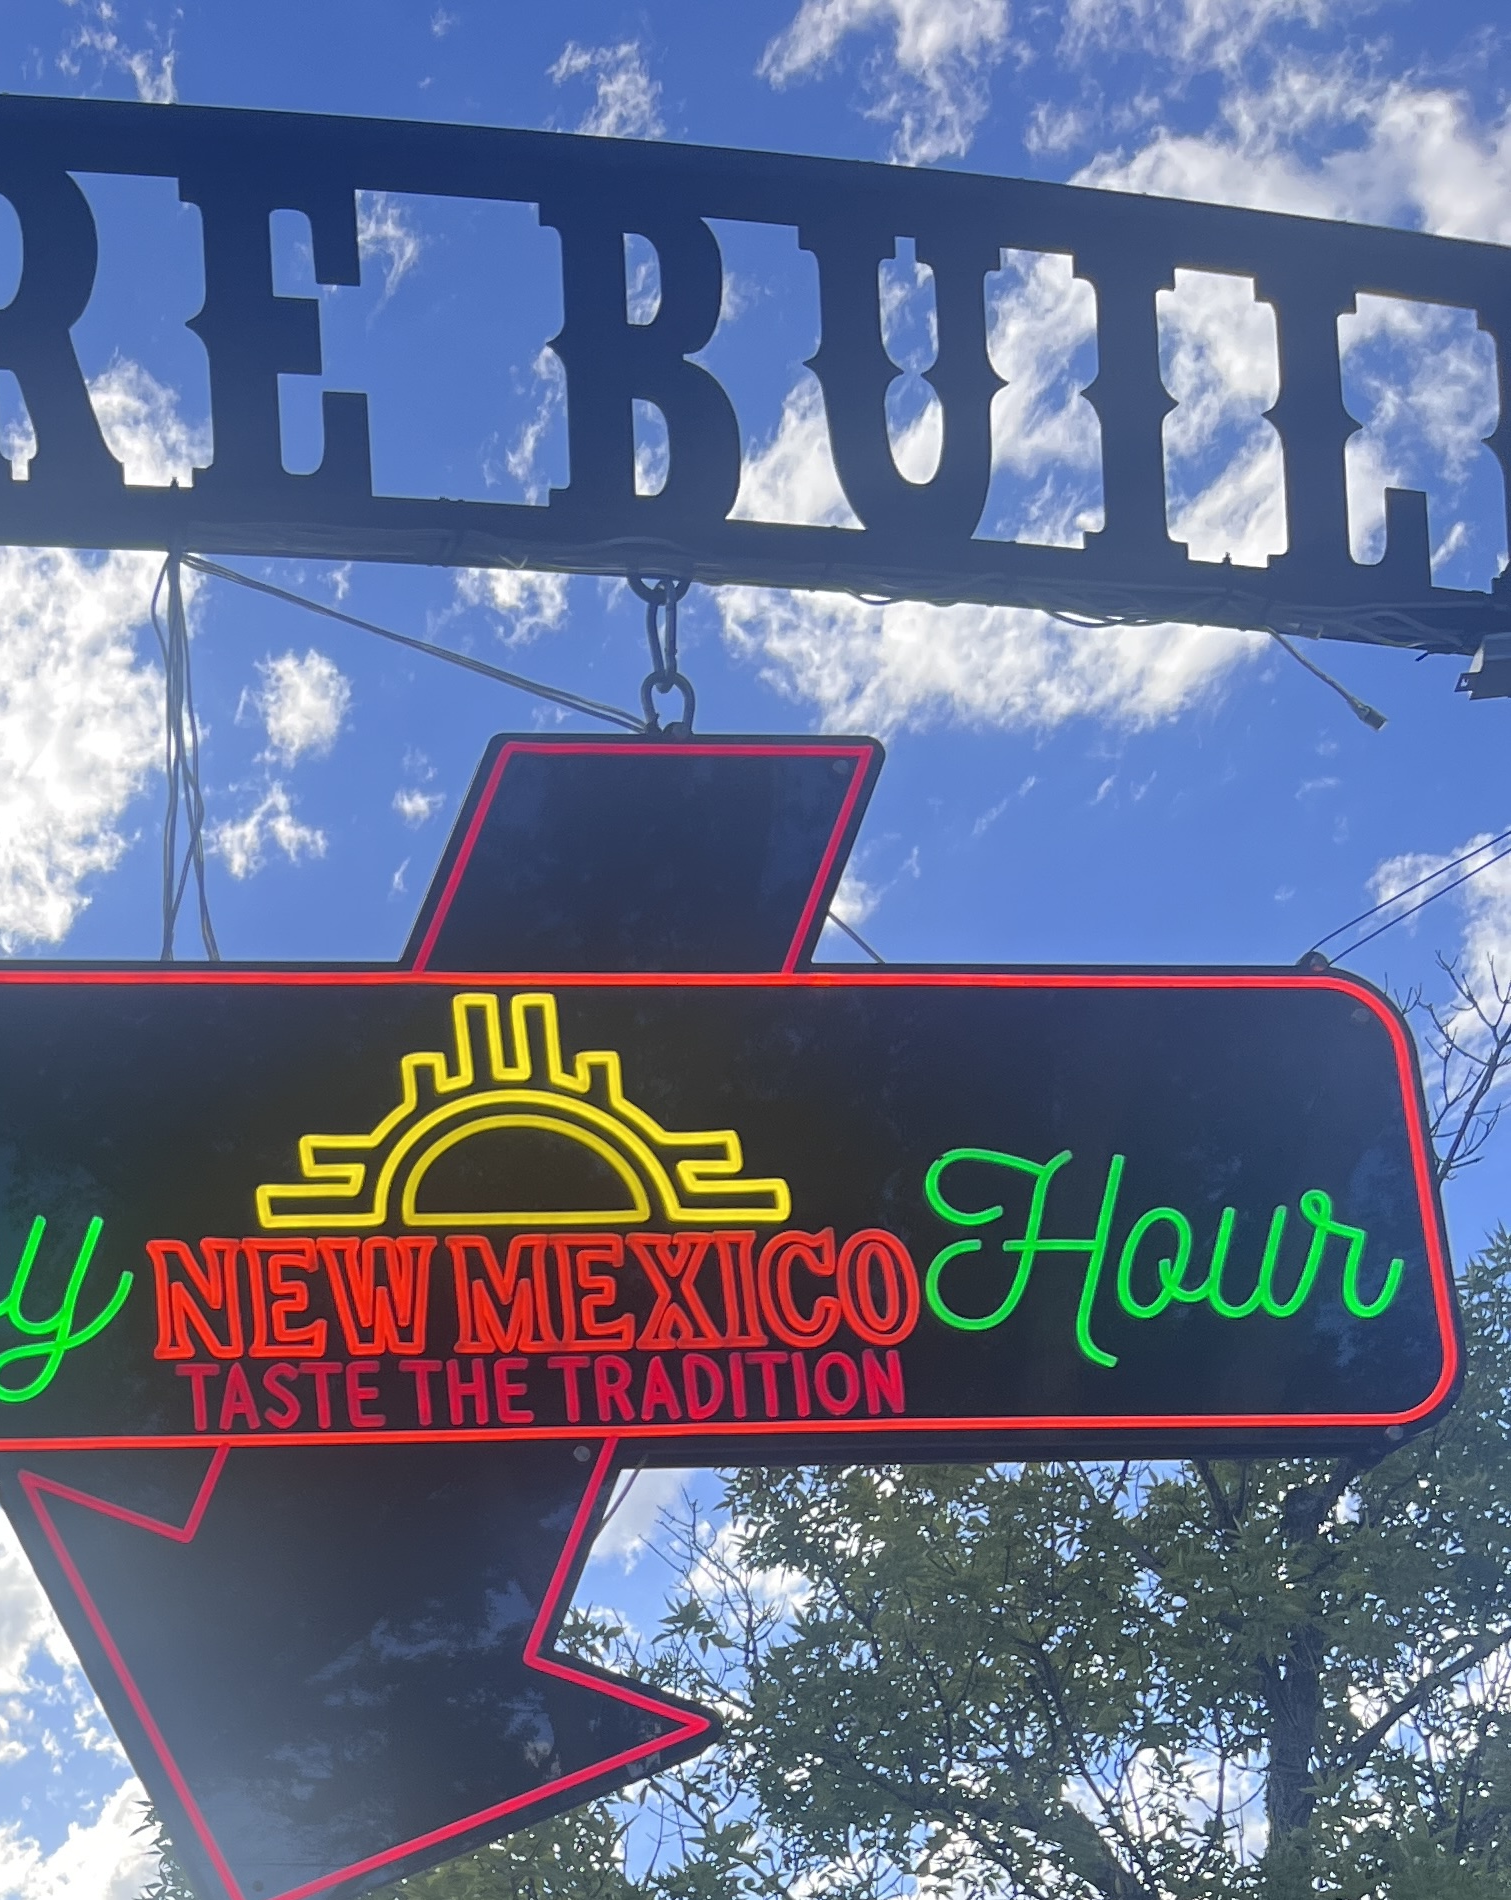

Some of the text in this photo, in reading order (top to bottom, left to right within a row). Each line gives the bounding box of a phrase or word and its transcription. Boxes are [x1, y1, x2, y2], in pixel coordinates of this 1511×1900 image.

[146, 1228, 921, 1360] NEW MEXICO
[923, 1146, 1404, 1368] Hour
[176, 1348, 907, 1431] TASTE THE TRADITION
